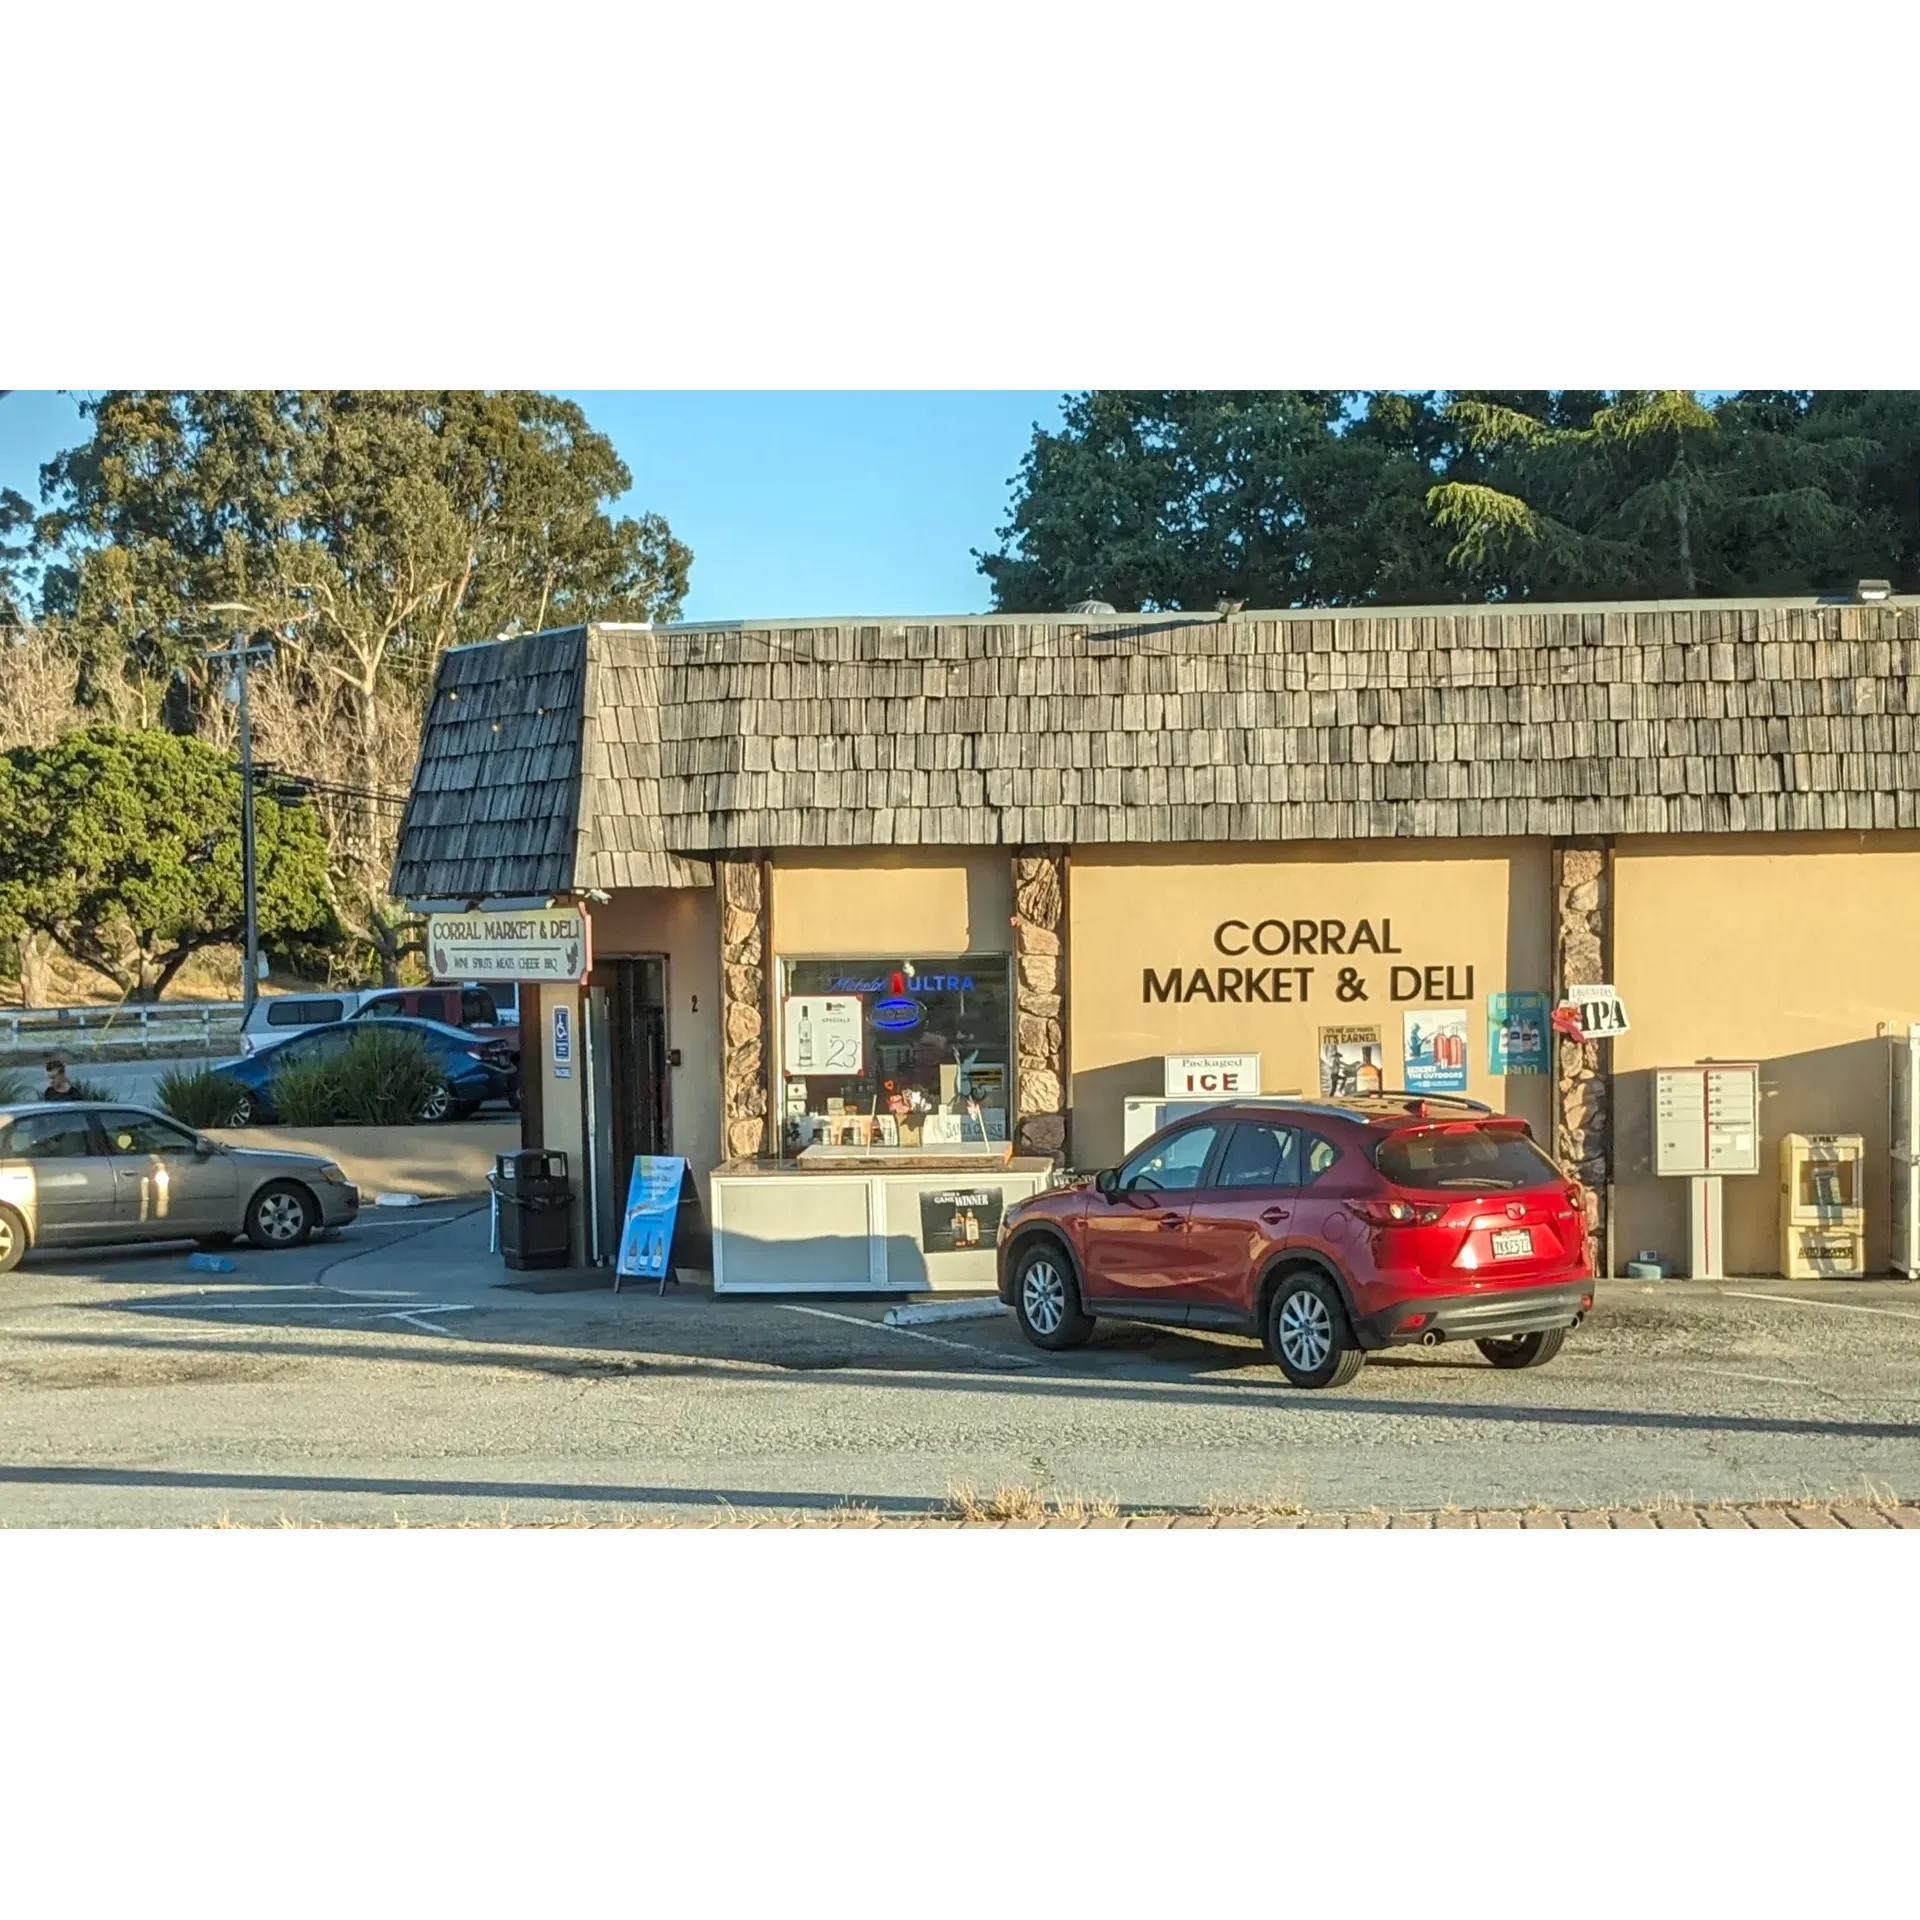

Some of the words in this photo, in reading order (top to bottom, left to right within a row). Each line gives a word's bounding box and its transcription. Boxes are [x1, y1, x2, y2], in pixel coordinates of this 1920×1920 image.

[433, 921, 481, 940] CORRAL
[484, 920, 536, 940] MARKET
[539, 920, 547, 939] &
[550, 919, 580, 939] DELI
[1213, 918, 1402, 956] CORRAL
[454, 957, 468, 969] WINE
[472, 957, 492, 969] SPIRITS
[496, 957, 515, 969] MEATS
[518, 957, 540, 970] CHEESE
[544, 957, 558, 972] BBQ
[907, 975, 976, 991] ULTRA
[1143, 967, 1314, 1003] MARKET
[1335, 966, 1369, 1003] &
[1390, 965, 1474, 1002] DELI
[1571, 986, 1612, 999] LAGUNITAS
[691, 994, 699, 1014] 2
[1581, 1000, 1627, 1032] IPA
[1323, 1034, 1339, 1044] IT'S
[1182, 1058, 1242, 1068] Packaged
[1186, 1073, 1239, 1092] ICE
[1424, 1071, 1463, 1080] OUTDOORS
[934, 1196, 954, 1204] GAME
[955, 1193, 989, 1206] WINNER
[1798, 1246, 1818, 1259] AUTO
[1820, 1246, 1854, 1259] SHOPPER
